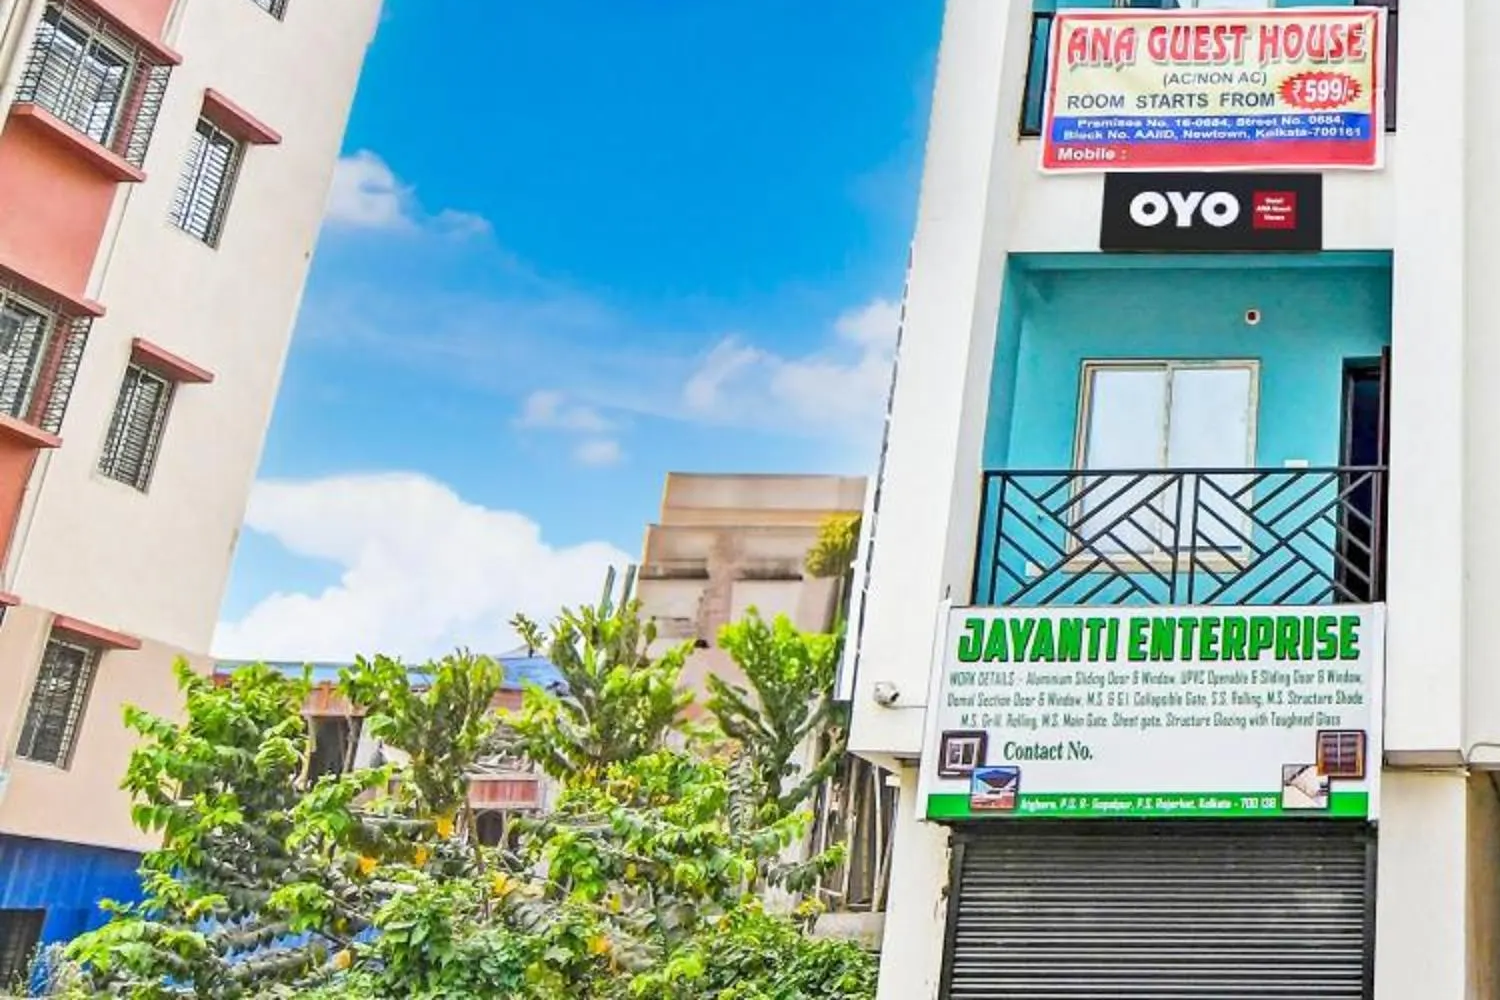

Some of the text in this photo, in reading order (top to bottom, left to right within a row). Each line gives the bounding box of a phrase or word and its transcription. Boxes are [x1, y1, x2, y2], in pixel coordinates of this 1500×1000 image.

[1066, 22, 1368, 67] ANA GUEST HOUSE
[1163, 71, 1267, 87] (AC/NON AC)
[1067, 91, 1275, 109] ROOM STARTS FROM
[1145, 119, 1169, 128] No.
[1235, 116, 1278, 127] Street
[1281, 115, 1304, 125] No.
[1063, 129, 1103, 140] Block
[1107, 129, 1131, 140] No.
[1183, 128, 1251, 139] Newtown,
[1057, 147, 1117, 161] Mobile
[1129, 191, 1240, 227] OYO
[957, 615, 1361, 662] JAYANTI ENTERPRISE
[977, 671, 1016, 686] DETAILS
[1107, 670, 1130, 685] Door
[1293, 669, 1315, 684] Door
[976, 692, 1011, 707] Section
[1013, 691, 1035, 707] Door
[1287, 691, 1333, 705] Structure
[1165, 712, 1211, 727] Structure
[1249, 712, 1269, 726] with
[1003, 740, 1094, 761] Contact No.
